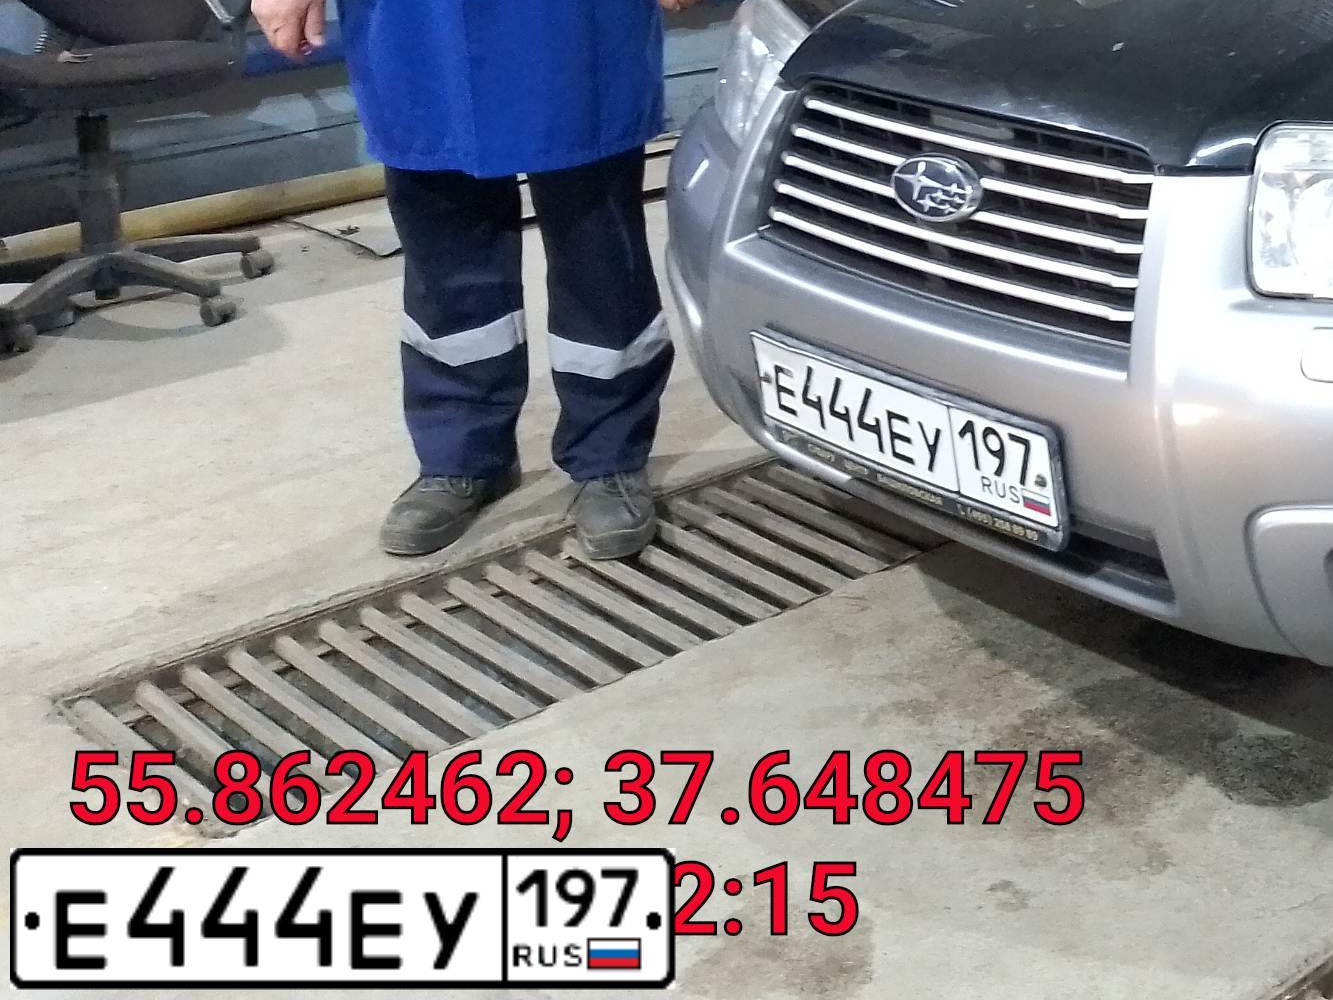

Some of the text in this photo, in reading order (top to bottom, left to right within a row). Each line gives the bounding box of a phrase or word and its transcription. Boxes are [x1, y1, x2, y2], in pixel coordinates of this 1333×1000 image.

[774, 364, 941, 473] Е444ЕУ
[959, 419, 1031, 487] 197
[980, 475, 1021, 504] RUS
